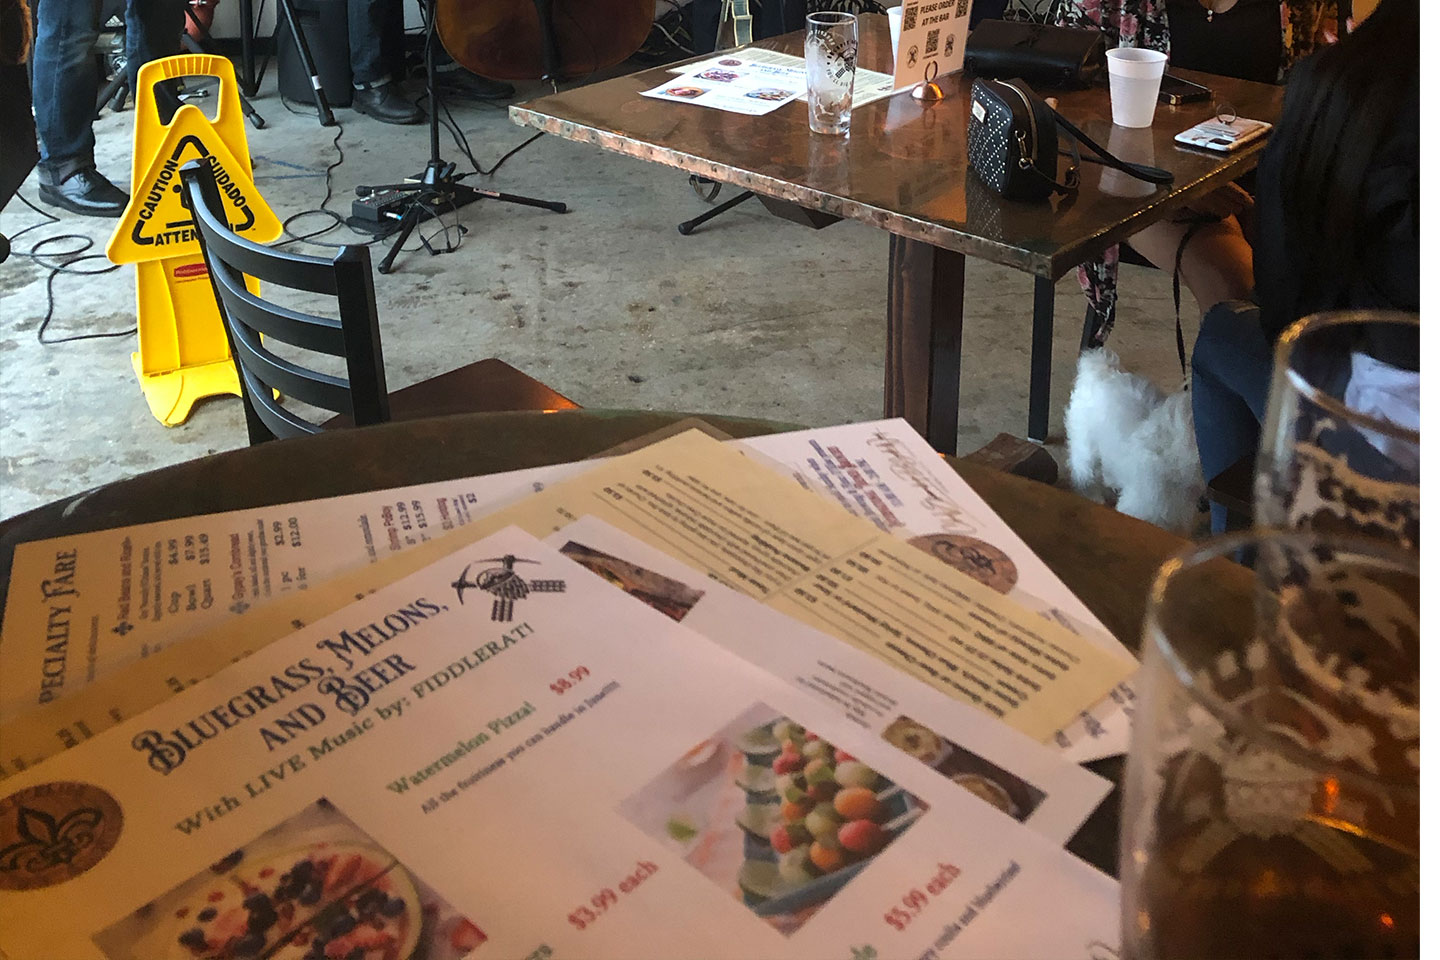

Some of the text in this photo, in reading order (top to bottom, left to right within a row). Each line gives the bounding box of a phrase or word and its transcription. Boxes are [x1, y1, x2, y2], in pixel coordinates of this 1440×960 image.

[920, 3, 938, 14] PLEASE
[938, 0, 955, 10] ORDER
[922, 13, 950, 26] AT THE BAR
[139, 159, 179, 220] CAUTION
[207, 155, 246, 208] CUIDADO
[155, 228, 200, 247] ATTEN
[396, 501, 412, 531] $12.99
[411, 500, 428, 529] $15.99
[273, 521, 285, 546] $2.99
[288, 516, 301, 547] $12.00
[167, 591, 182, 613] Cup
[186, 584, 197, 611] Bowl
[201, 578, 214, 609] Quart
[38, 548, 80, 704] PECIALTY FARE
[131, 657, 334, 776] BLUEGRASS,
[316, 596, 449, 672] MELONS,
[258, 652, 416, 753] AND BEER
[174, 794, 241, 836] With
[244, 753, 306, 800] LIVE
[306, 716, 375, 762] Music
[374, 695, 412, 721] by:
[410, 621, 537, 700] FIDDLERAT!
[385, 730, 490, 795] Watermelon
[487, 700, 537, 736] Pizza!
[549, 665, 591, 696] $8.99
[567, 858, 659, 931] $3.99 each
[926, 862, 961, 896] each
